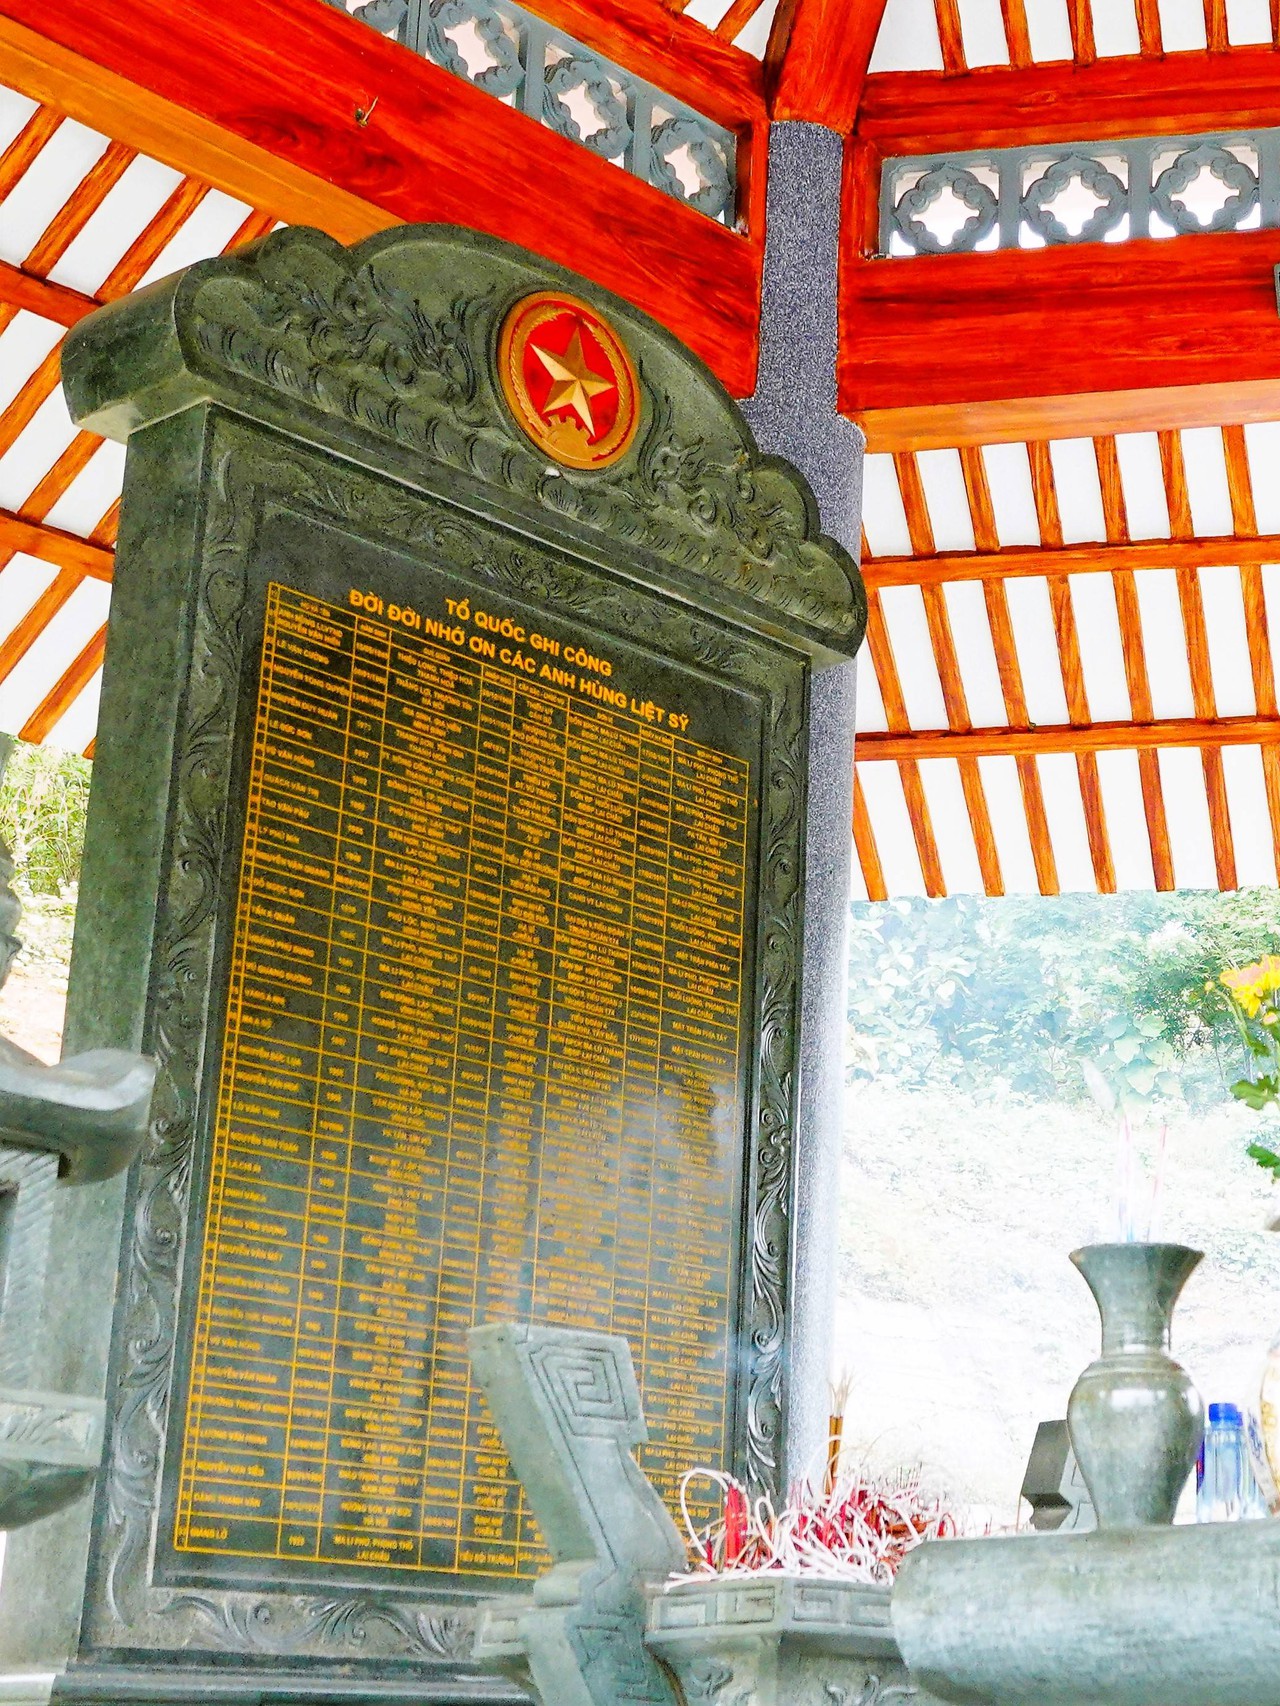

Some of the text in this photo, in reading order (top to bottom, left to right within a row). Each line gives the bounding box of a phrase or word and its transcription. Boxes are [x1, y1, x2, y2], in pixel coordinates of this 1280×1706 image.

[349, 589, 689, 732] ĐỜI ĐỜI NHỚ ƠN CÁC ANH HÙNG LIỆT SỸ
[446, 598, 612, 677] TỔ QUỐC GHI CÔNG
